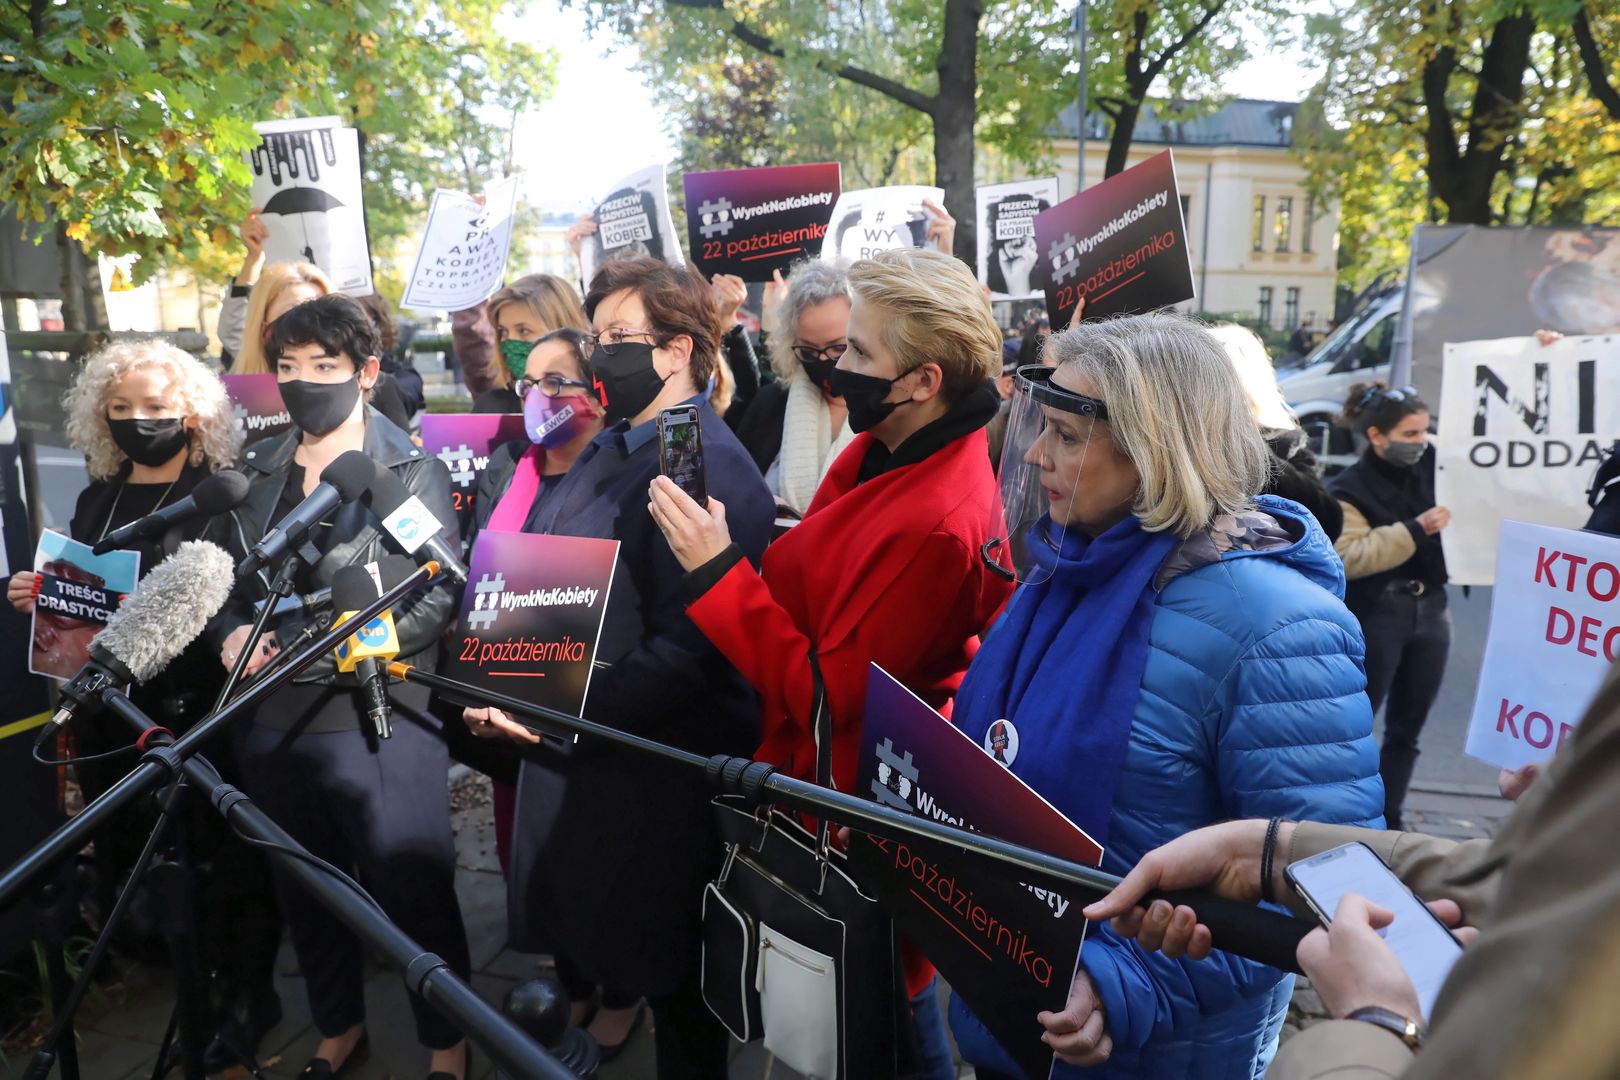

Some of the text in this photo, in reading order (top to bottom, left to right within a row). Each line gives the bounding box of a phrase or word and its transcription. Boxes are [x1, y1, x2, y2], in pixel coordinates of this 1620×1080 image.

[998, 200, 1040, 211] PRZECIW
[998, 208, 1040, 219] SADYSTOM
[606, 225, 647, 245] KOBIET
[703, 222, 829, 260] 22 października
[864, 228, 896, 243] WY
[1000, 226, 1033, 237] KOBIE
[1056, 229, 1176, 311] 22 października
[247, 411, 291, 430] Wyrok
[539, 408, 573, 435] LEWICA
[1470, 439, 1603, 468] ODDA
[1535, 547, 1620, 602] KTO
[56, 580, 106, 605] TREŚCI
[38, 594, 115, 621] DRASTYCZ
[459, 635, 586, 667] 22 października
[896, 843, 1053, 988] października
